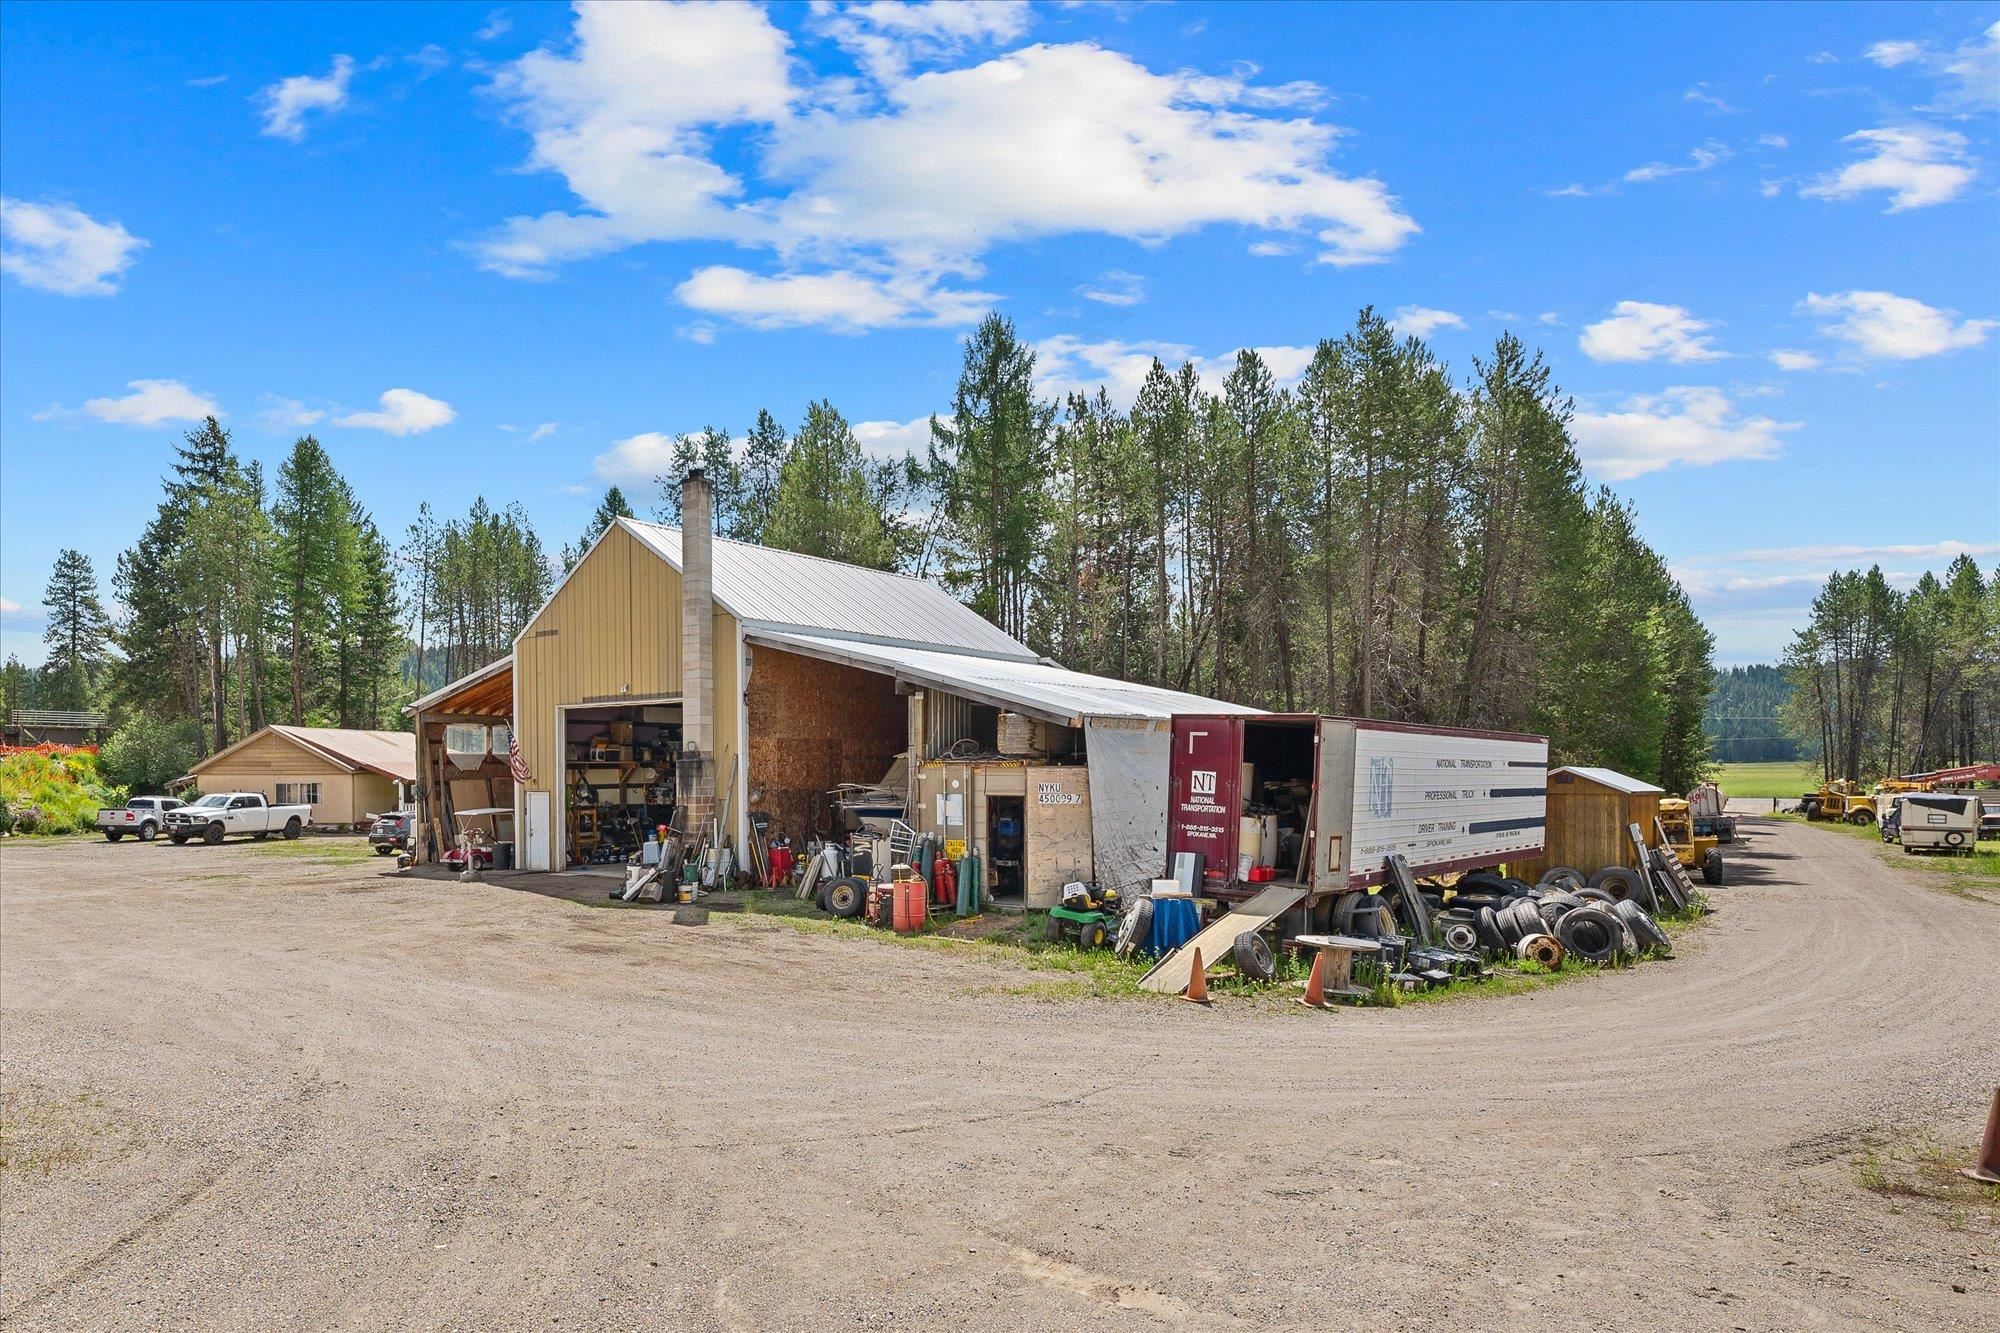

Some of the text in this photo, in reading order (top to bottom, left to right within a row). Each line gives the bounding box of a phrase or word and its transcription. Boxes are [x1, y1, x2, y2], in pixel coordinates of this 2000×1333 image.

[1436, 759, 1492, 769] NATIONAL TRANSPORTATION
[1193, 773, 1215, 791] NT
[1039, 783, 1061, 792] NYKU
[1075, 794, 1081, 803] 7
[1425, 790, 1474, 800] PROFESSIONAL TRUCK
[1190, 796, 1215, 805] NATIONAL
[1181, 803, 1226, 814] TRANSPORTATION
[1418, 821, 1456, 834] DRIVER TRAINING
